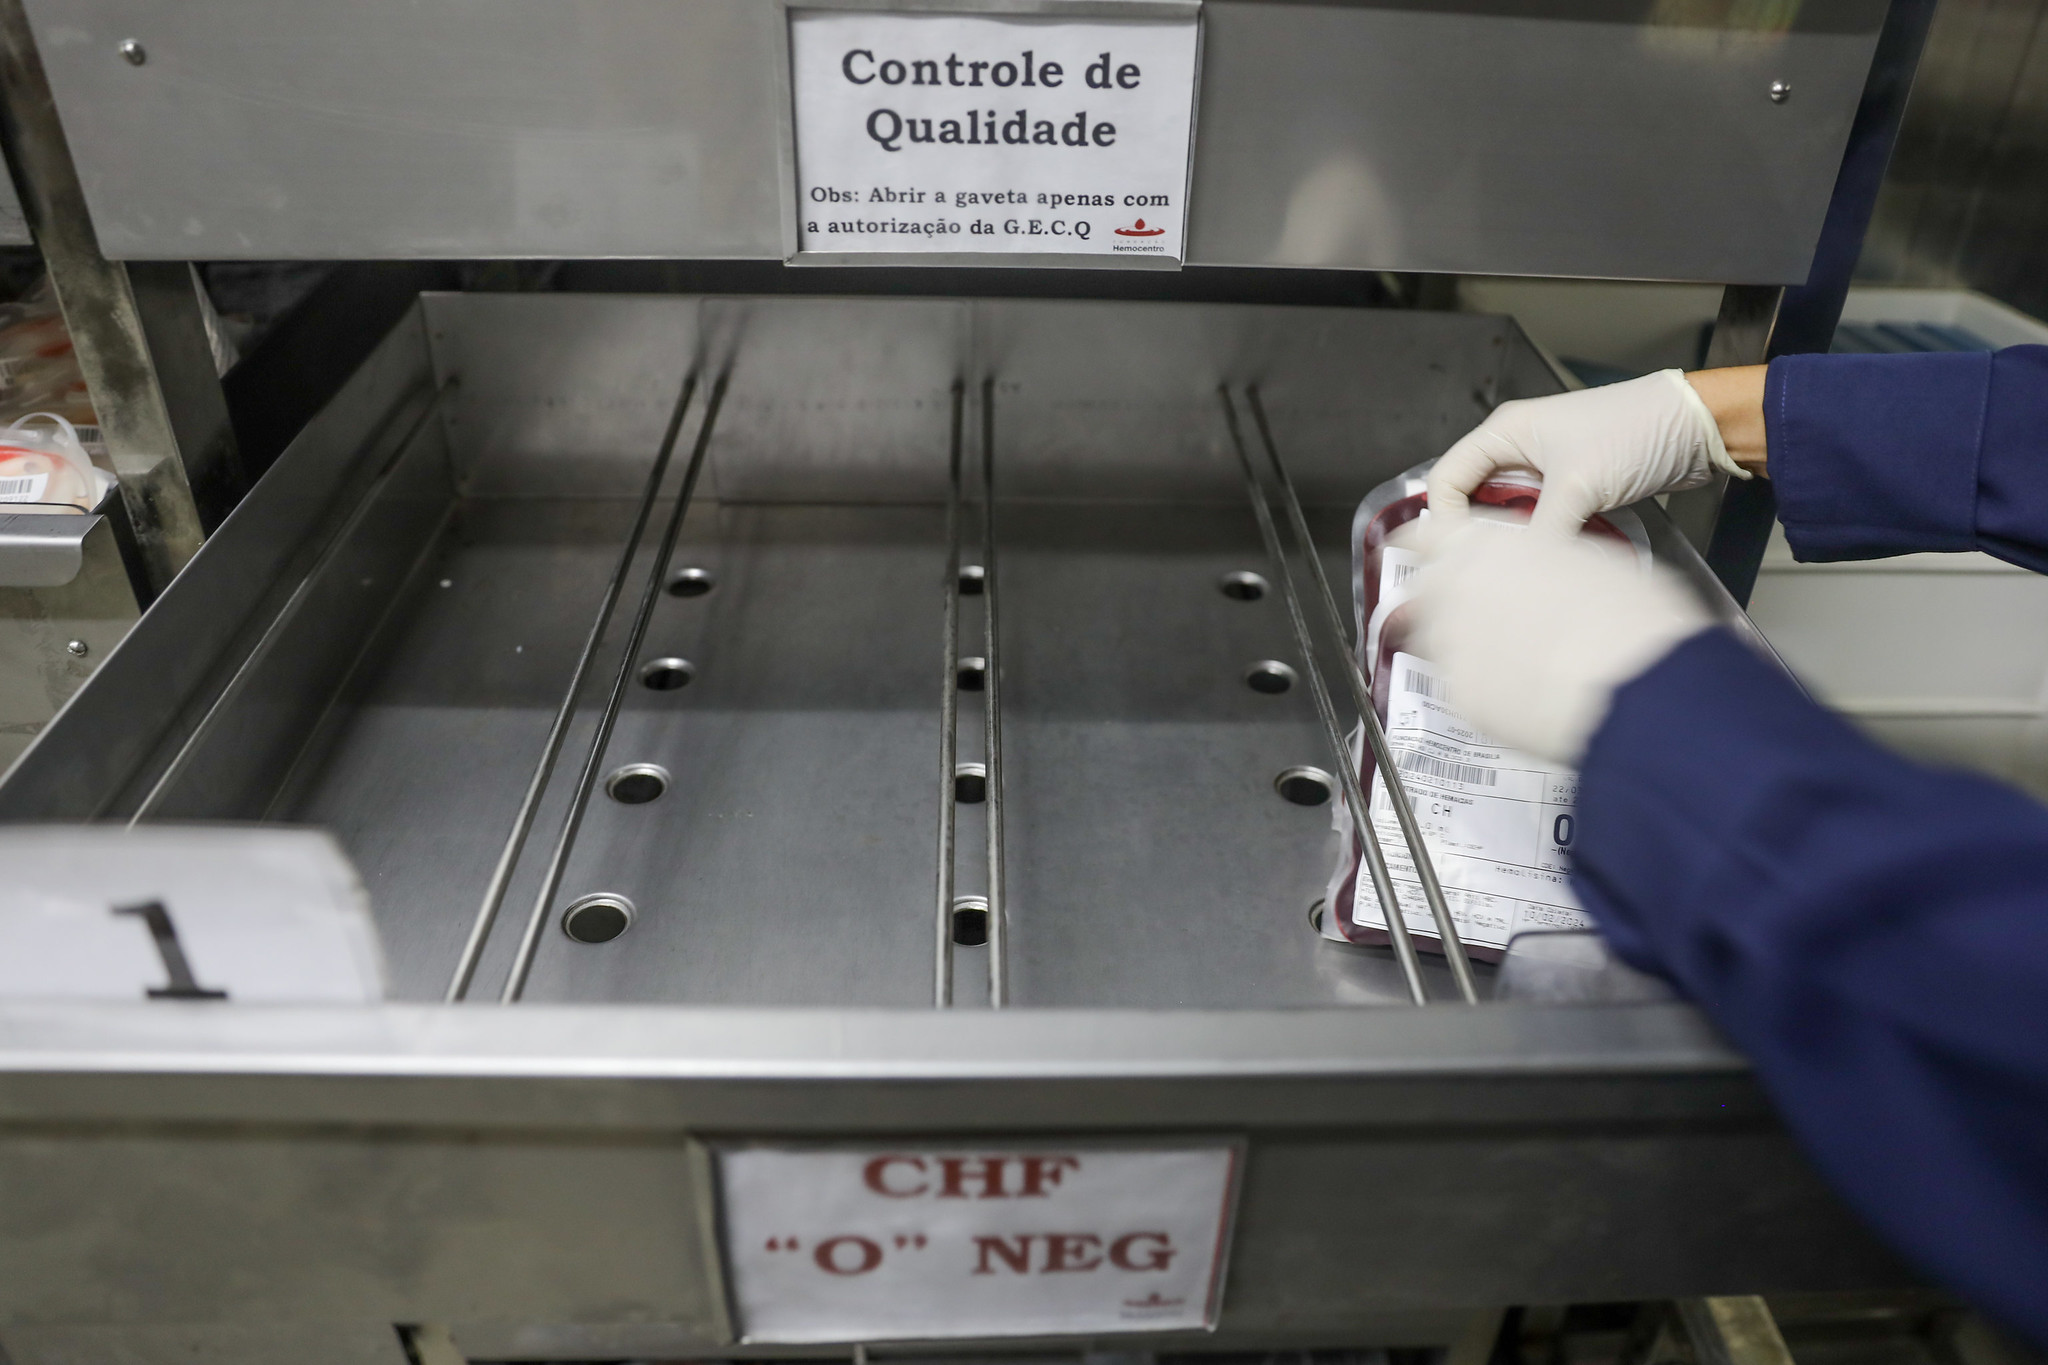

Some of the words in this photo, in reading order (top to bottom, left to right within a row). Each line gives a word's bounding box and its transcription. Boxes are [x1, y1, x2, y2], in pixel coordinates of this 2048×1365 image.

[842, 49, 1064, 88] Controle
[1085, 52, 1141, 89] de
[866, 108, 1117, 152] Qualidade
[810, 187, 859, 204] Obs:
[869, 188, 926, 205] Abrir
[935, 191, 947, 205] a
[956, 190, 1028, 208] gaveta
[1037, 192, 1115, 210] apenas
[1123, 192, 1170, 207] com
[807, 221, 819, 233] a
[828, 217, 961, 239] autorização
[970, 219, 995, 235] da
[1004, 219, 1091, 240] G.E.C.Q
[1112, 244, 1165, 252] Hemocentro
[109, 900, 229, 1000] 1
[863, 1155, 1082, 1199] CHF
[972, 1231, 1177, 1276] NEG
